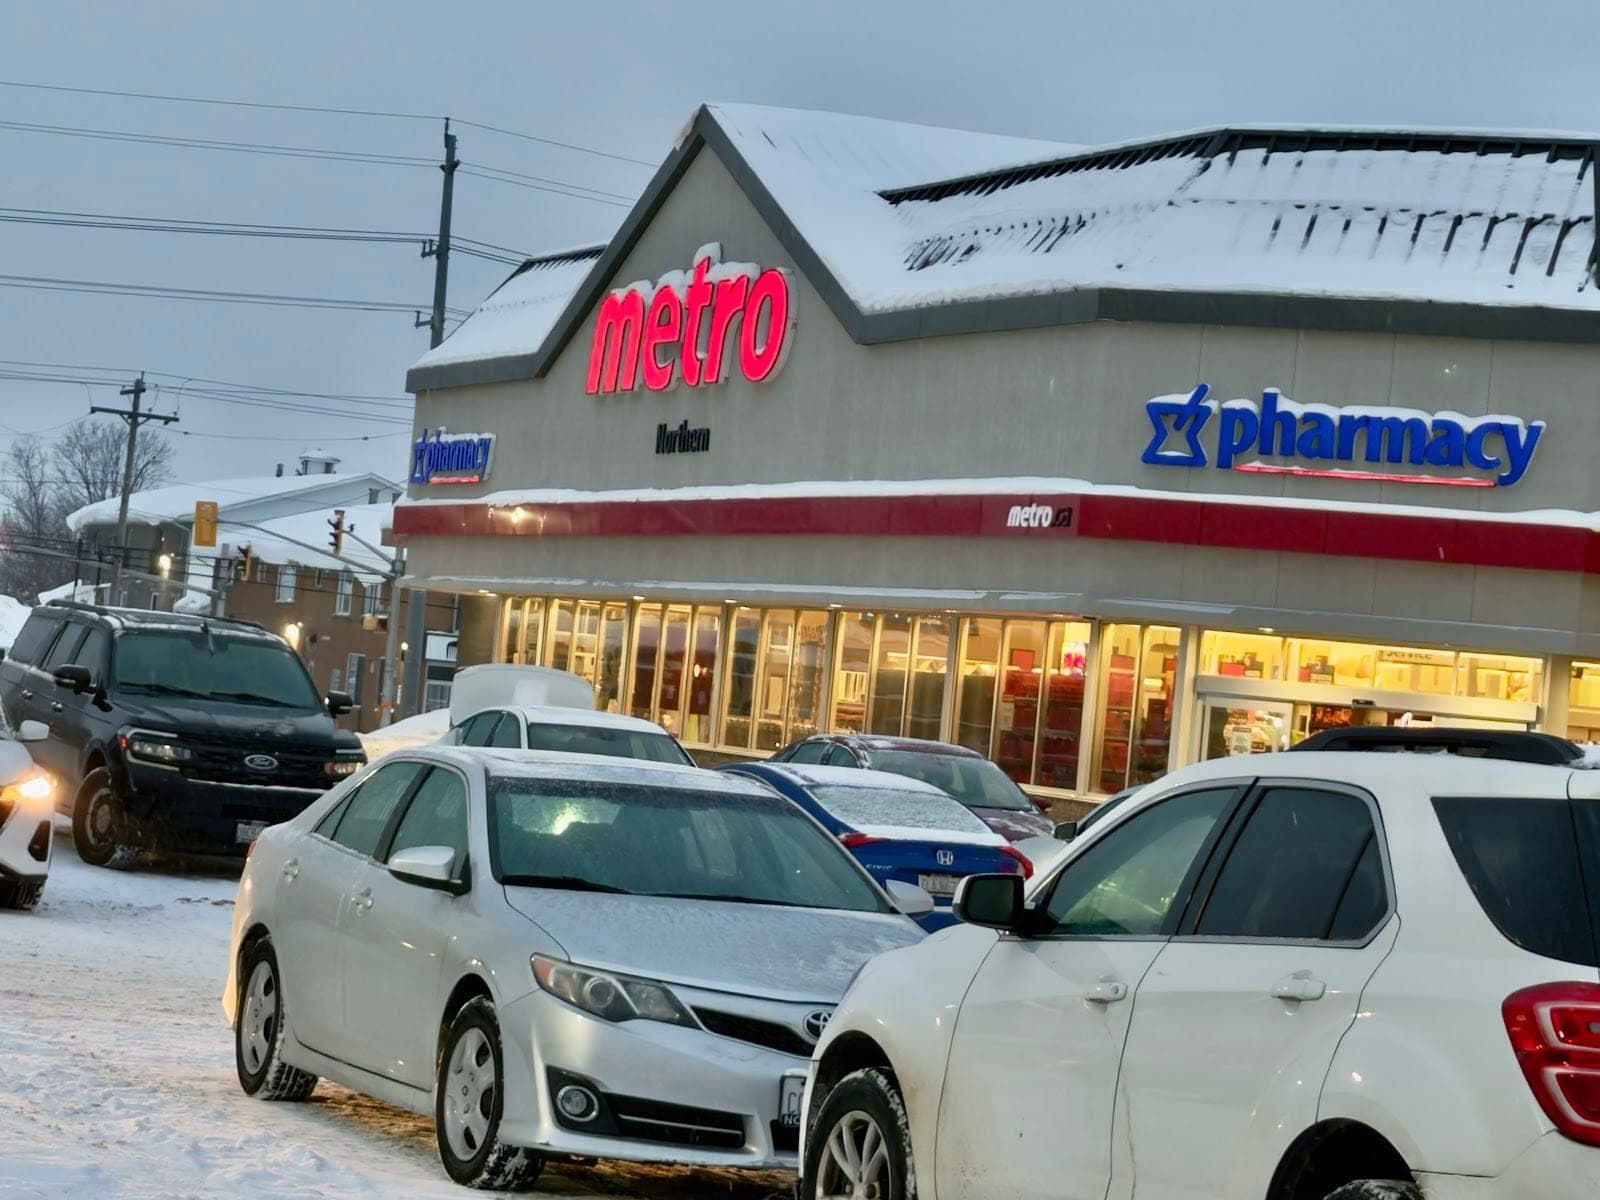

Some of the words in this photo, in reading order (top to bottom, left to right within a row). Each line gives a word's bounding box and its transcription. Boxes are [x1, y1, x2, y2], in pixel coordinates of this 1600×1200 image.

[585, 256, 788, 395] metro
[425, 429, 492, 482] pharmacy
[655, 419, 710, 454] Northern
[1217, 391, 1544, 486] pharmacy
